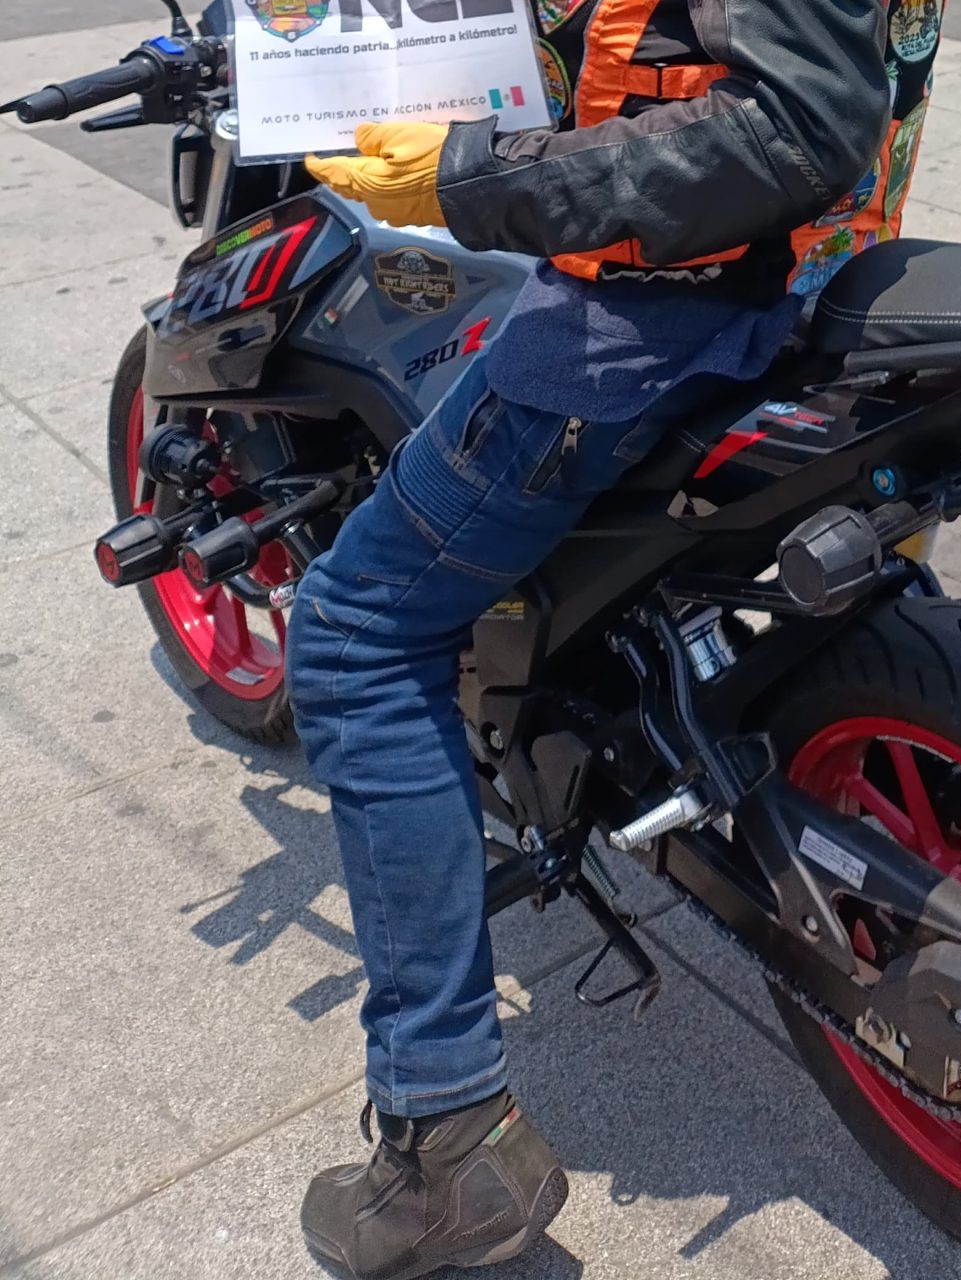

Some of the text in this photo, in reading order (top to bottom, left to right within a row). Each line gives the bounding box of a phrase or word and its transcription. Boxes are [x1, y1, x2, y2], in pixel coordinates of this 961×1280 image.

[250, 51, 260, 61] 11
[262, 48, 291, 60] años
[295, 44, 350, 58] haciendo
[449, 34, 457, 43] a
[459, 24, 518, 40] kilómetro!
[261, 114, 301, 125] MOTO
[307, 109, 367, 121] TURISMO
[372, 107, 389, 117] EN
